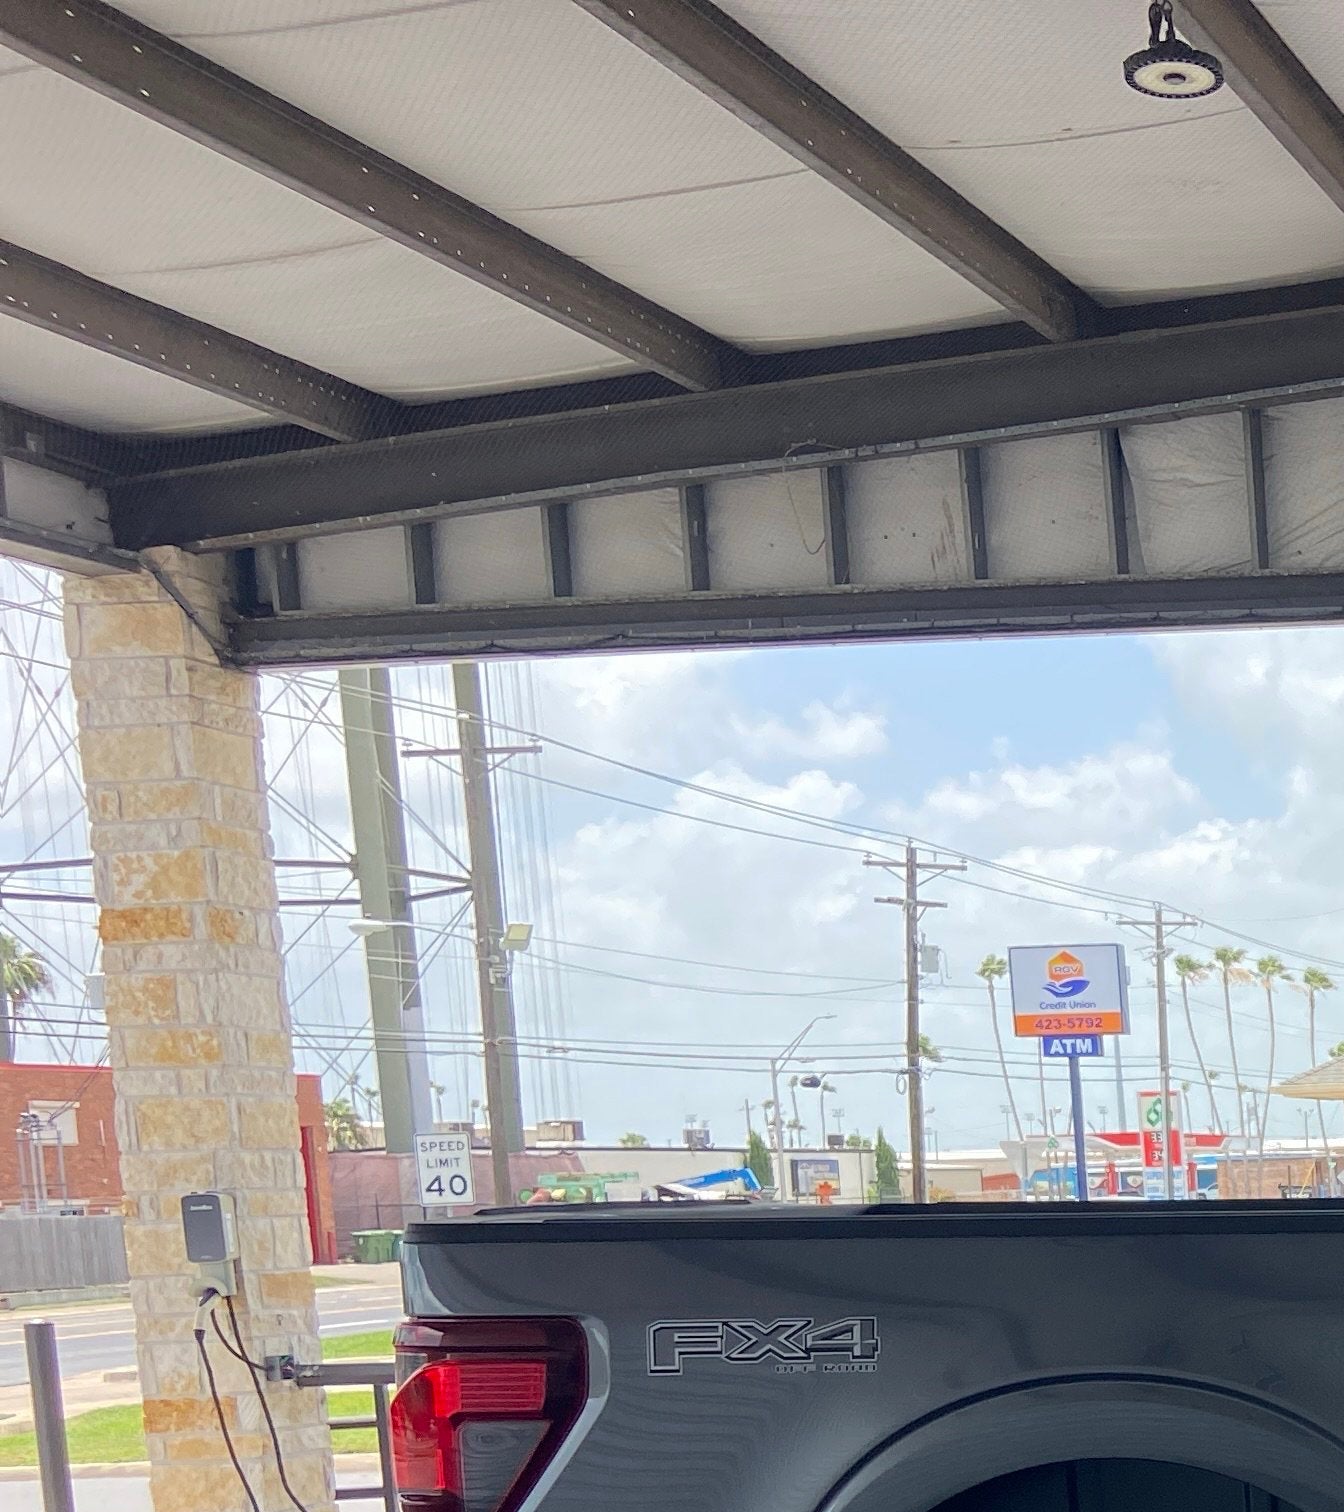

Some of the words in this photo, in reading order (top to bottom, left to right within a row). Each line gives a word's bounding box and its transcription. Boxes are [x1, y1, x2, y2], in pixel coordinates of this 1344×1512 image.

[1054, 966, 1079, 974] RGV
[1039, 1001, 1067, 1010] Credit
[1069, 1001, 1097, 1010] Union
[1035, 1017, 1103, 1030] 423-5792
[1050, 1038, 1093, 1055] ATM
[420, 1140, 465, 1152] SPEED
[426, 1157, 461, 1169] LIMIT
[425, 1174, 468, 1197] 40
[647, 1316, 880, 1376] FX4
